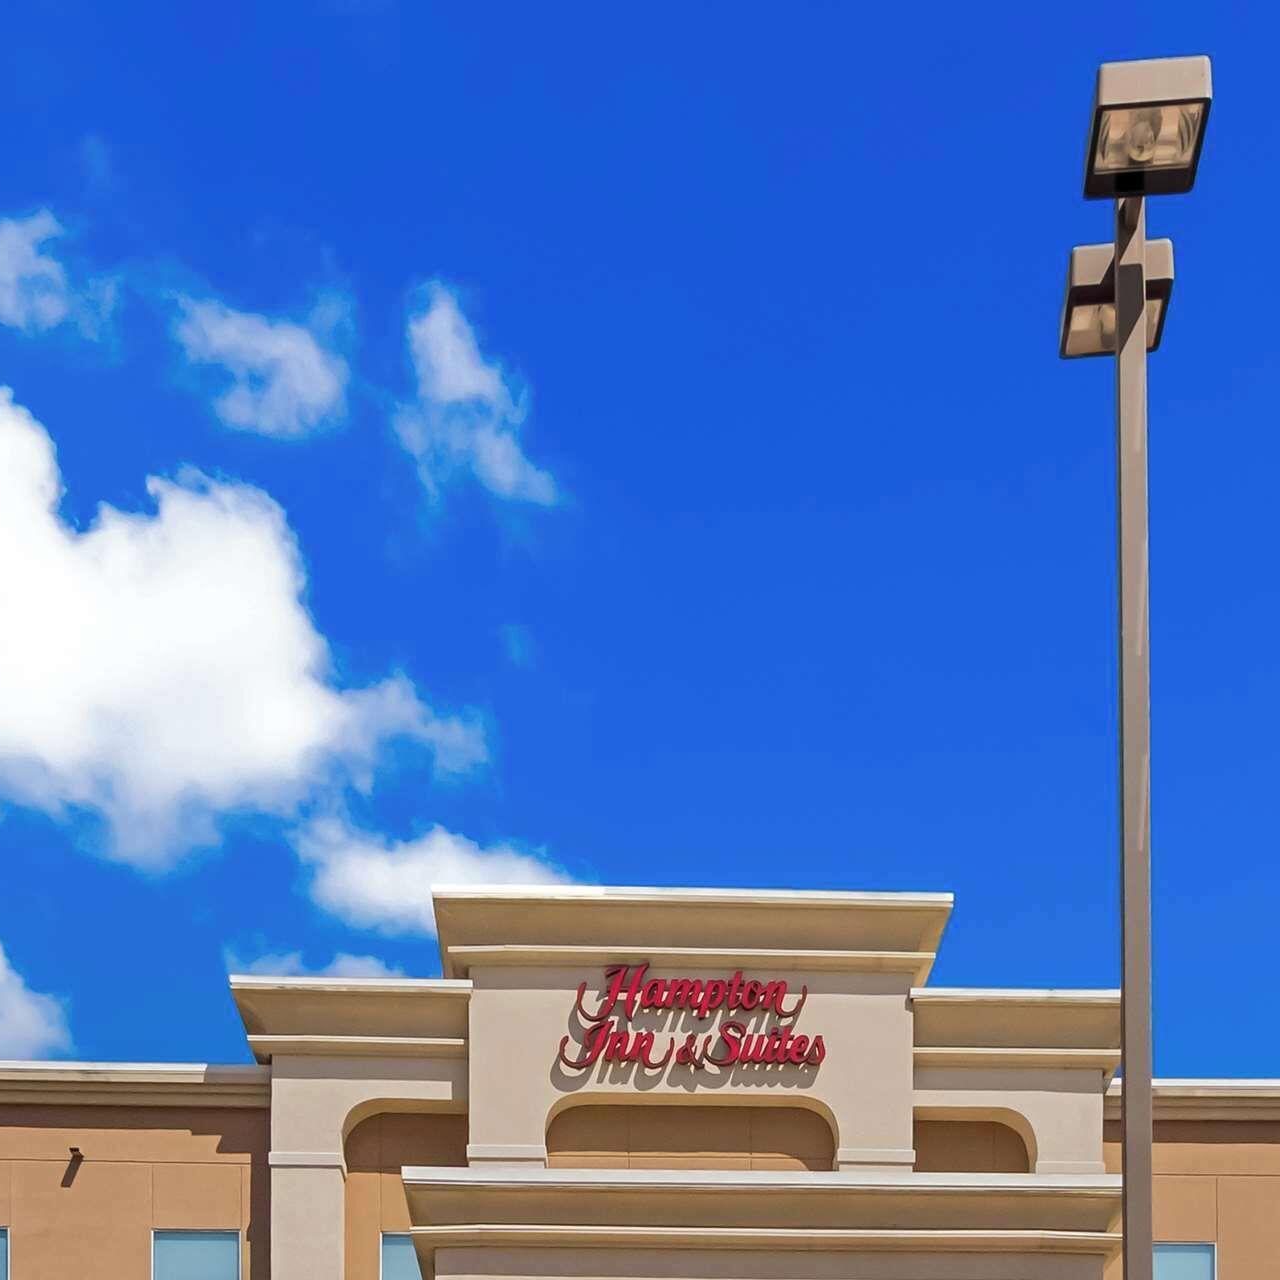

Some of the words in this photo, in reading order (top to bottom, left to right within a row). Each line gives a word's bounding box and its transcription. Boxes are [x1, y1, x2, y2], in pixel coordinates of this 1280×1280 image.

[576, 962, 807, 1022] Hampton
[559, 1020, 675, 1069] Inn
[676, 1033, 706, 1069] &
[704, 1020, 826, 1067] Suites
